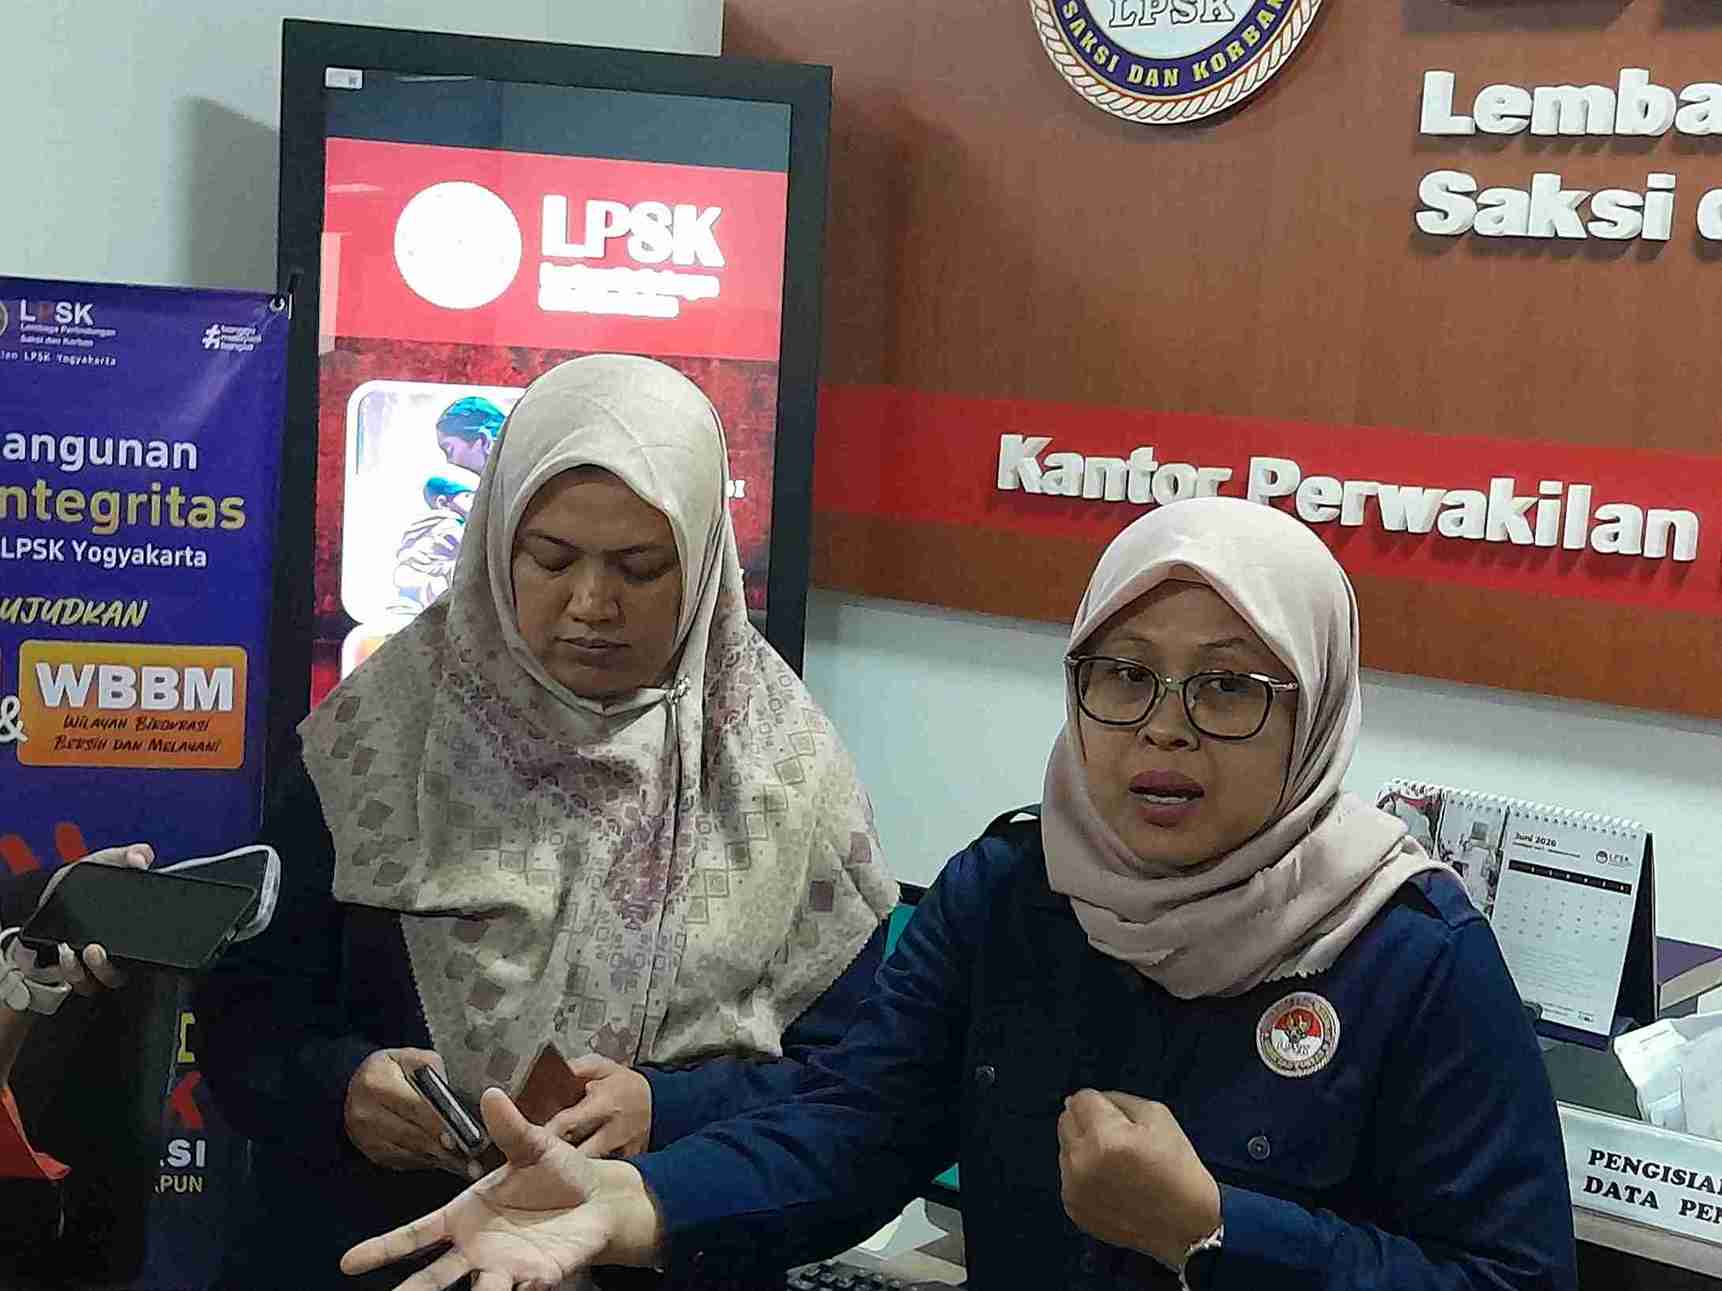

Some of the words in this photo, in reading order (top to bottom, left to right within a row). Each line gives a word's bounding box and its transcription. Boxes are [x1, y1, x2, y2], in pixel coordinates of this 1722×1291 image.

[1062, 0, 1120, 73] SAKSI
[1127, 64, 1180, 88] DAN
[1420, 67, 1722, 136] Lemba
[1415, 169, 1676, 241] Saksi
[541, 194, 726, 268] LPSK
[56, 353, 116, 366] Yogyakarta
[2, 432, 197, 471] angunan
[0, 479, 246, 534] ntegritas
[997, 433, 1233, 506] Kantor
[1248, 456, 1700, 561] Perwakilan
[0, 537, 64, 563] LPSK
[71, 540, 207, 568] Yogyakarta
[35, 662, 233, 711] WBBM
[160, 1139, 206, 1168] SI
[1588, 1149, 1722, 1196] PENGISIA
[155, 1174, 203, 1193] PUN
[1583, 1175, 1659, 1209] DATA
